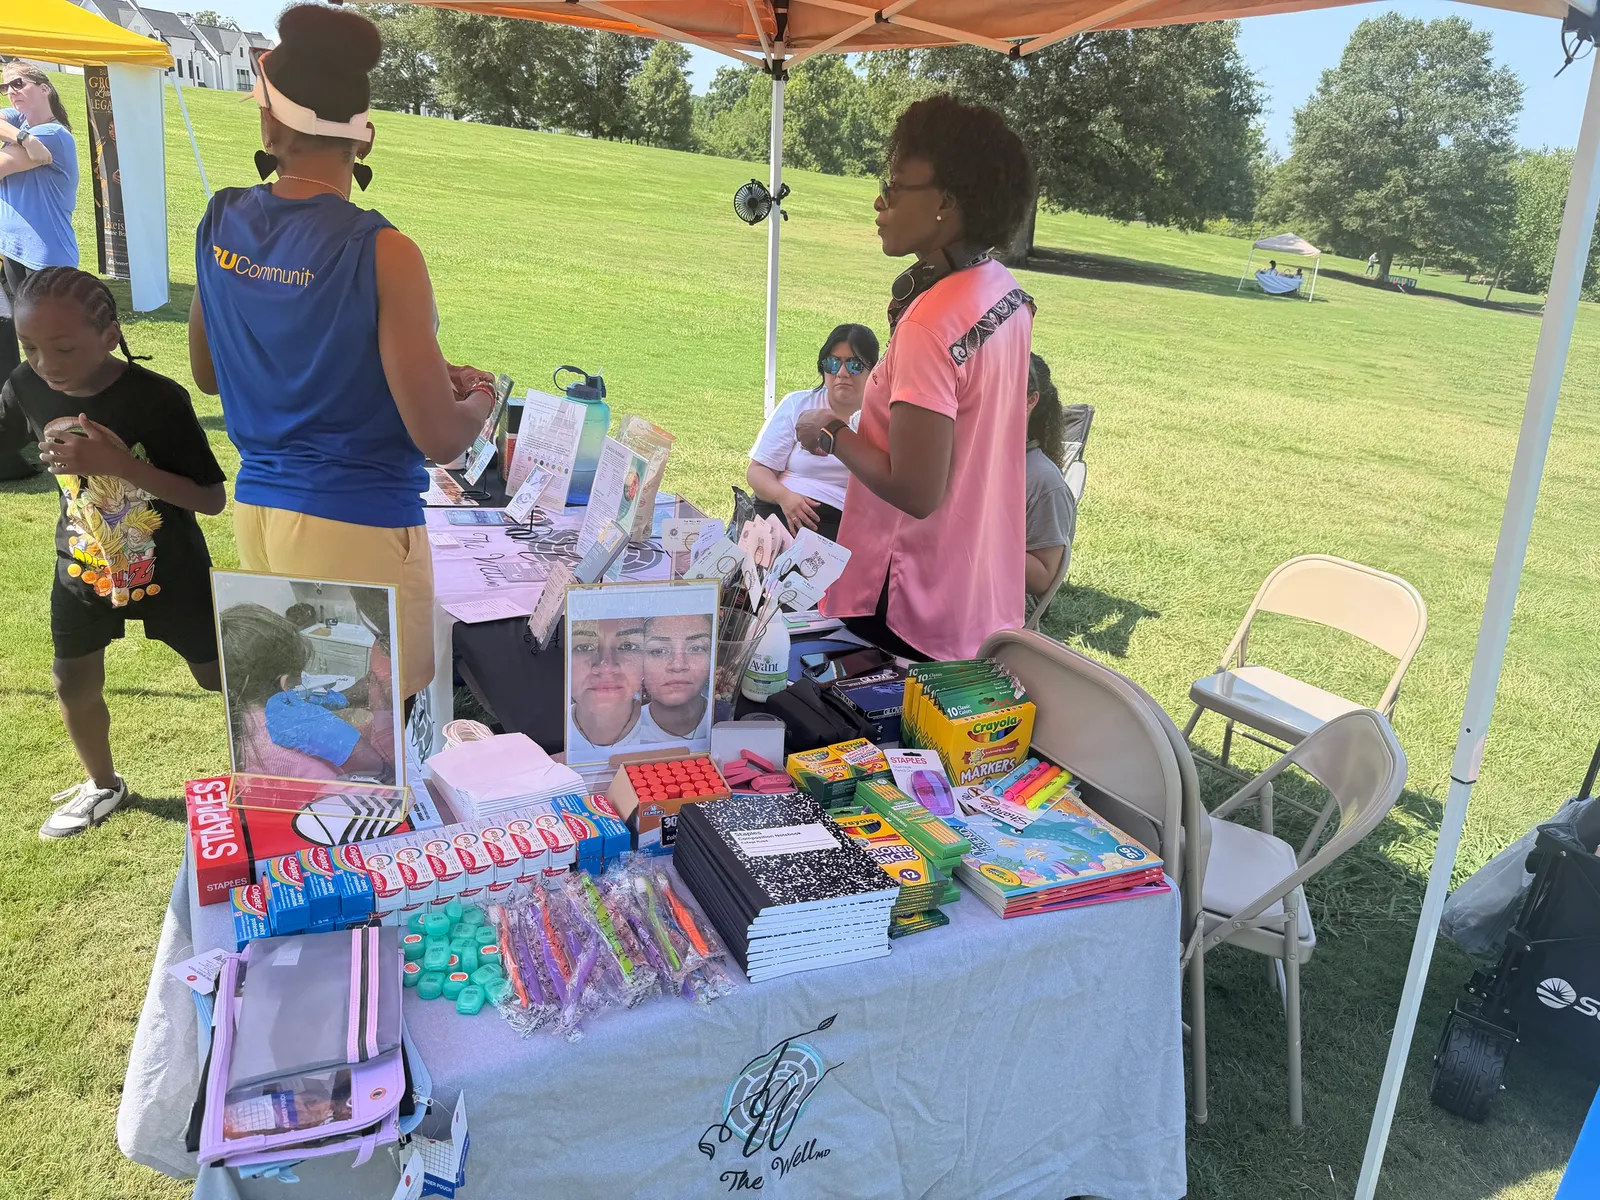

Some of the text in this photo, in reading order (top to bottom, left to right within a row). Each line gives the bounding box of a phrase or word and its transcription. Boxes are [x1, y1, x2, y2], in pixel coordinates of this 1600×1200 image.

[749, 659, 779, 672] Avant
[946, 706, 959, 718] 10
[957, 703, 971, 711] Classic
[972, 716, 1018, 734] Crayola
[890, 756, 928, 765] STAPLES
[960, 758, 1016, 785] MARKERS
[596, 794, 614, 814] Colgate
[192, 780, 239, 860] STAPLES
[567, 817, 585, 839] Colgate
[663, 816, 678, 829] 30
[515, 834, 528, 853] Colgate
[542, 829, 556, 847] Colgate
[348, 845, 362, 867] Colgate
[488, 842, 501, 861] Colgate
[524, 850, 544, 858] Colgate
[552, 845, 572, 853] Colgate
[866, 845, 915, 858] OLORED
[316, 847, 330, 870] Colgate
[430, 855, 443, 875] Colgate
[460, 849, 473, 868] Colgate
[497, 859, 517, 867] Colgate
[875, 853, 920, 865] ENCILS
[287, 856, 300, 881] Colgate
[401, 864, 414, 883] Colgate
[468, 866, 489, 874] Colgate
[546, 869, 565, 877] Colgate
[902, 870, 919, 879] 12
[206, 877, 248, 892] STAPLES
[372, 871, 383, 891] Colgate
[439, 873, 460, 881] Colgate
[379, 889, 400, 897] Colgate
[409, 882, 430, 890] Colgate
[489, 883, 510, 891] Colgate
[252, 885, 263, 910] Colgate
[1573, 996, 1600, 1022] S
[719, 1168, 765, 1193] The
